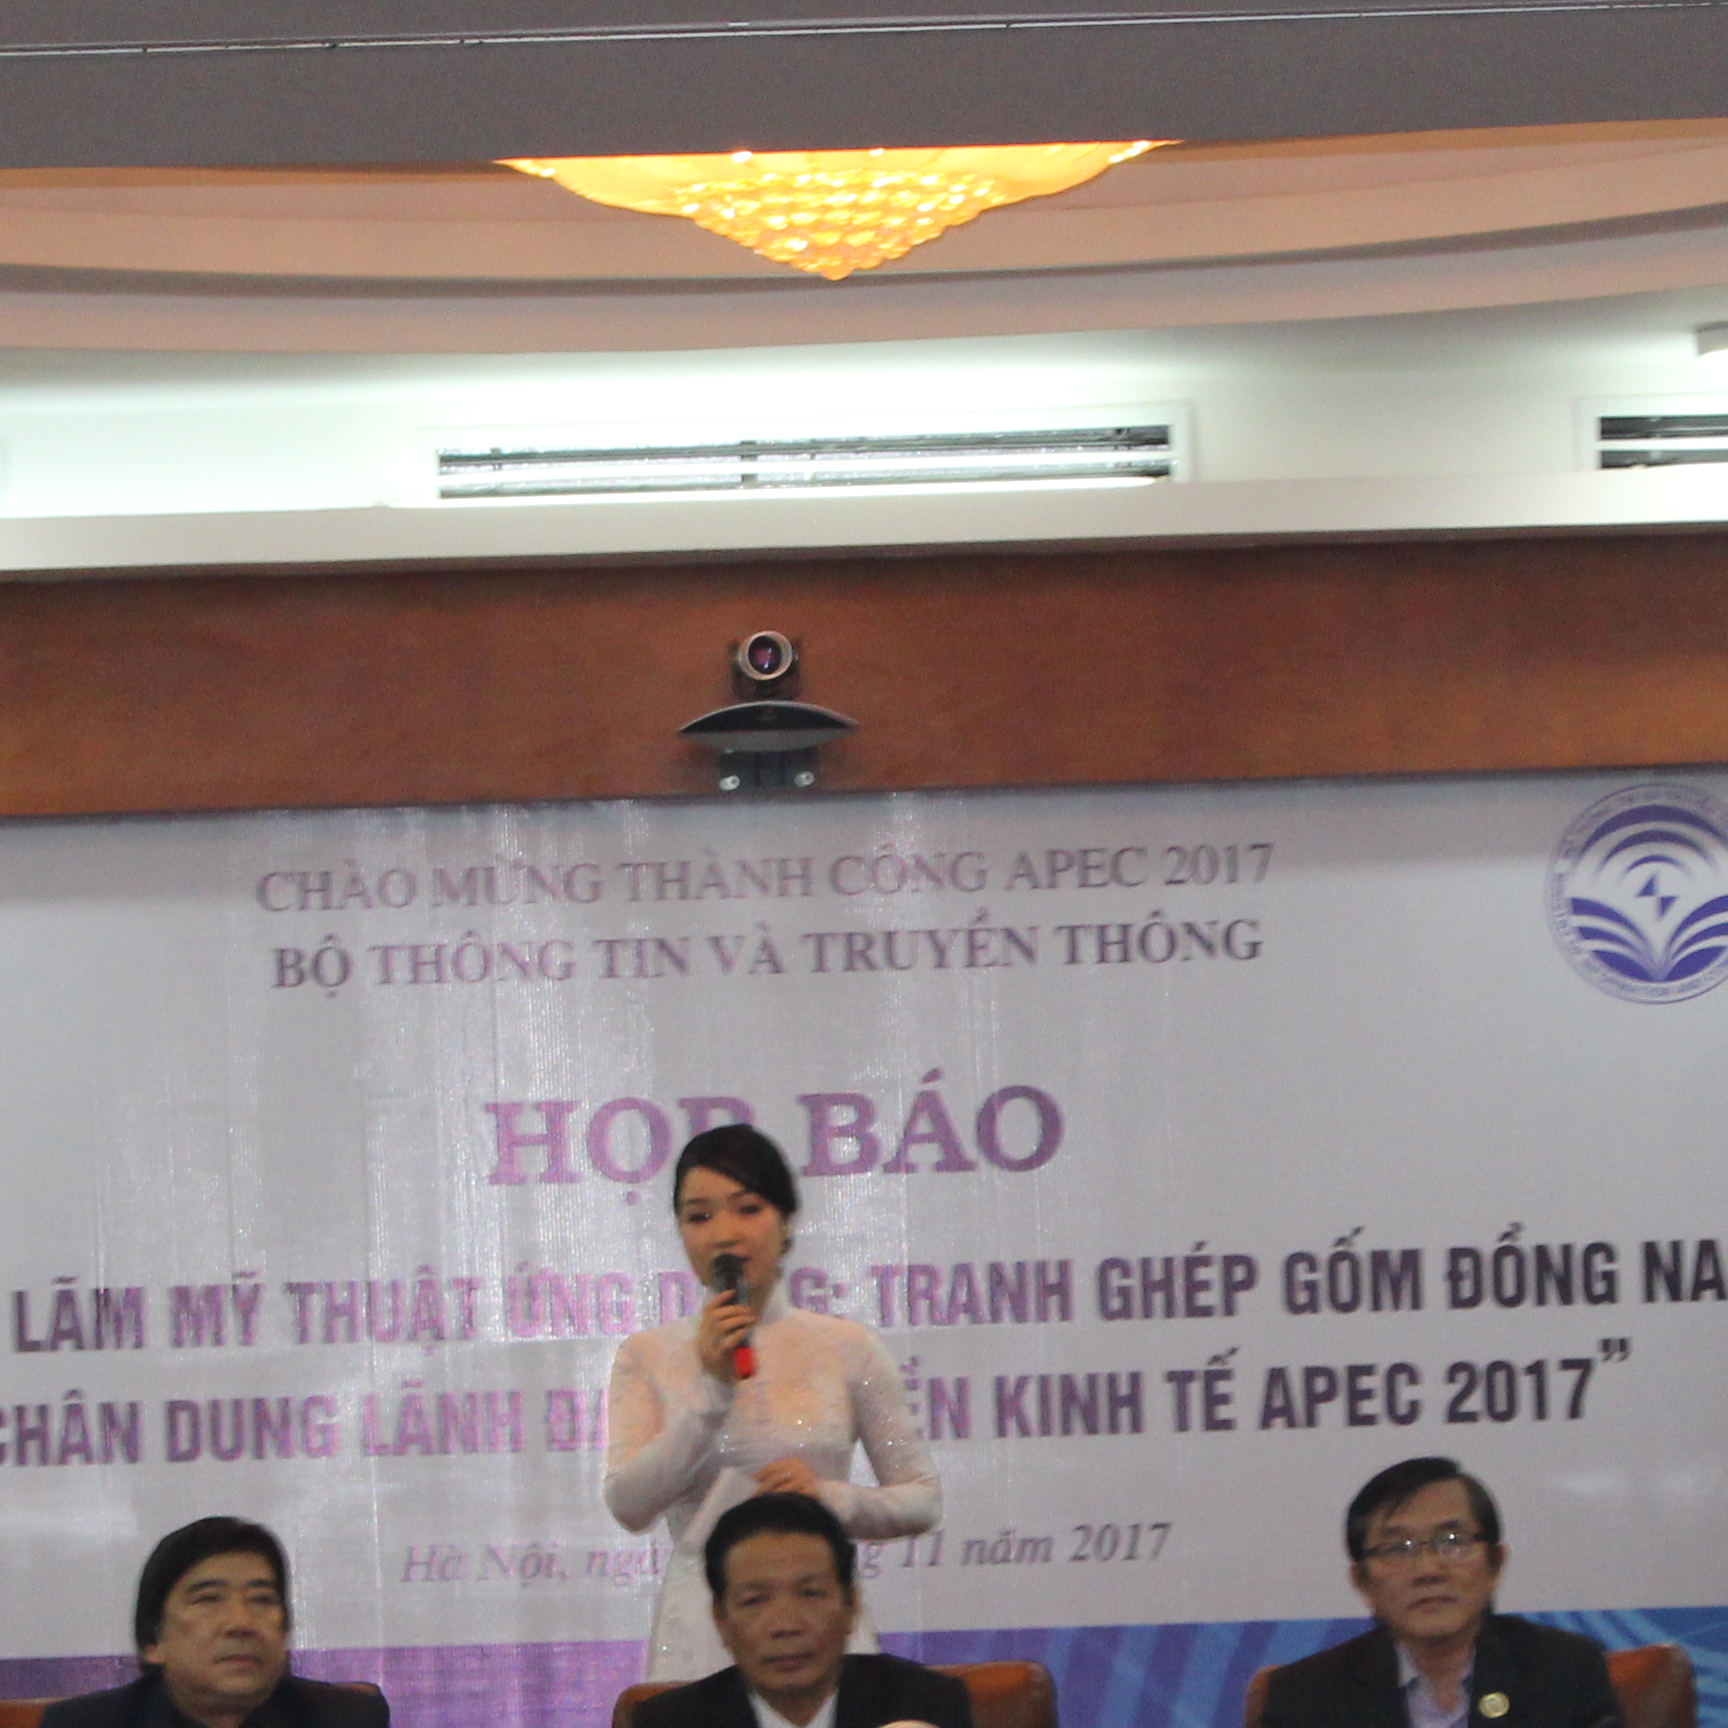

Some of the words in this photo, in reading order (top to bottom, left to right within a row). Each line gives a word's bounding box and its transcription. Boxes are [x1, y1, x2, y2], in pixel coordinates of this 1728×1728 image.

[256, 858, 418, 911] CHÀO
[431, 855, 605, 907] MỪNG
[618, 848, 817, 901] THÀNH
[828, 844, 989, 896] CÔNG
[1005, 846, 1150, 891] APEC
[1164, 842, 1274, 886] 2017
[270, 933, 355, 998] BỘ
[368, 930, 577, 986] THÔNG
[592, 936, 692, 980] TIN
[707, 920, 785, 974] VÀ
[802, 906, 1040, 973] TRUYỀN
[1053, 908, 1266, 966] THÔNG
[796, 1067, 1065, 1177] BÁO
[11, 1275, 146, 1354] LÃM
[169, 1269, 267, 1349] MỸ
[284, 1263, 484, 1357] THUẬT
[506, 1260, 638, 1339] ỨNG
[867, 1258, 1076, 1328] TRANH
[1096, 1240, 1258, 1322] GHÉP
[1282, 1225, 1424, 1315] GỐM
[1443, 1221, 1619, 1310] ĐỒNG
[165, 1394, 341, 1464] DUNG
[360, 1379, 526, 1457] LÃNH
[992, 1370, 1145, 1439] KINH
[1164, 1346, 1241, 1434] TẾ
[1258, 1360, 1421, 1431] APEC
[401, 1542, 469, 1583] Hà
[961, 1528, 1056, 1567] năm
[1069, 1521, 1172, 1562] 2017
